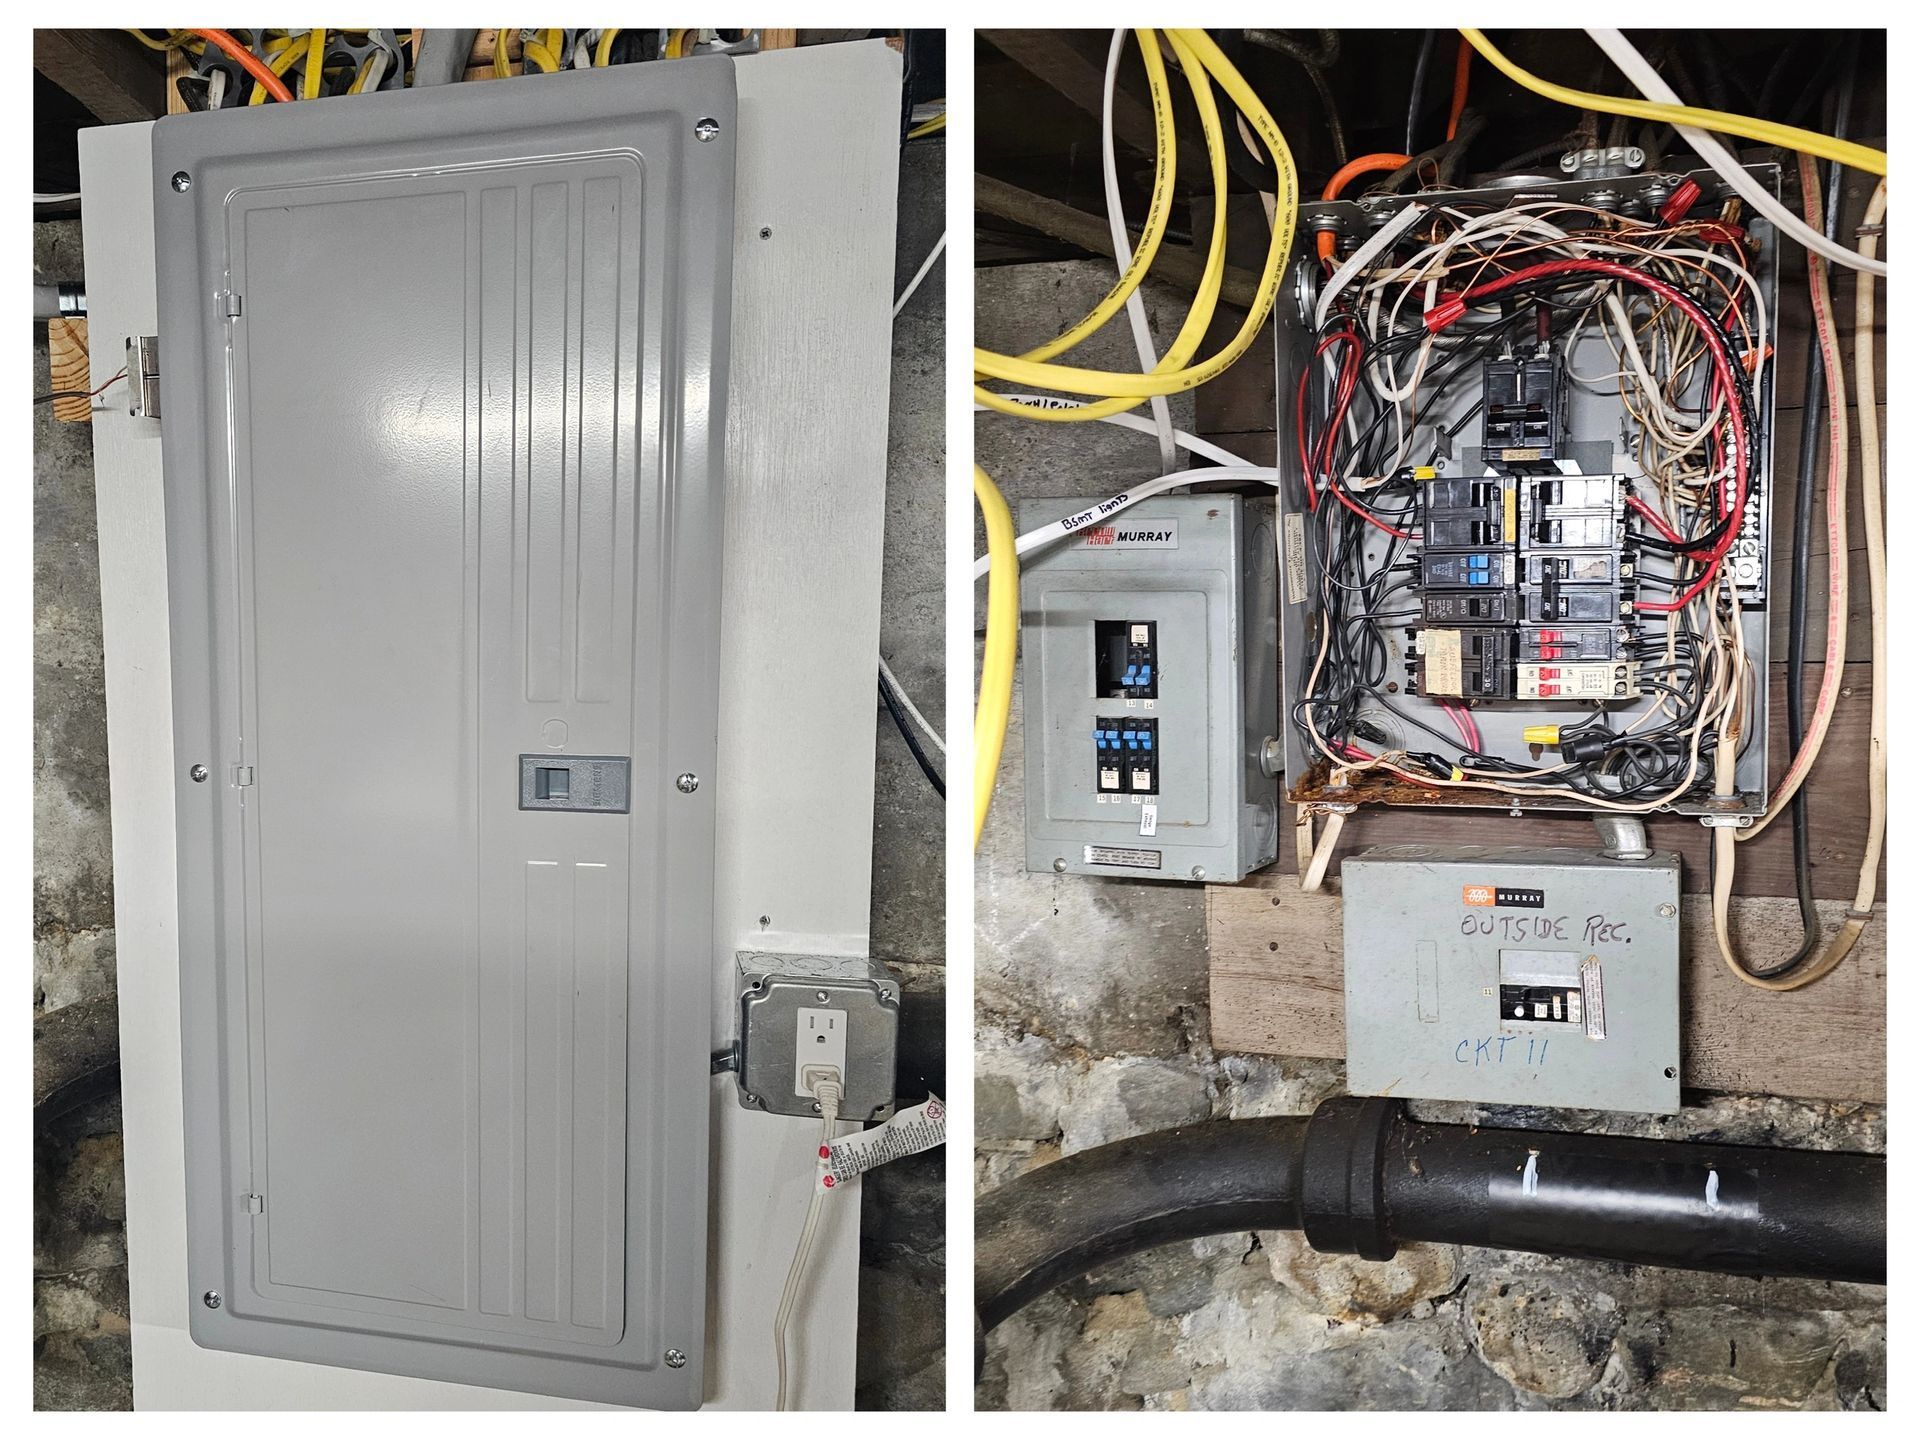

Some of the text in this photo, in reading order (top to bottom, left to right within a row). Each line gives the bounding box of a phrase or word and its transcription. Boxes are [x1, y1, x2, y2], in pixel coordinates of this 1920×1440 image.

[1117, 531, 1172, 542] MURRAY
[1498, 894, 1541, 902] MURRAY
[1461, 914, 1569, 943] OUTSIDE
[1455, 1036, 1548, 1067] CKT 11
